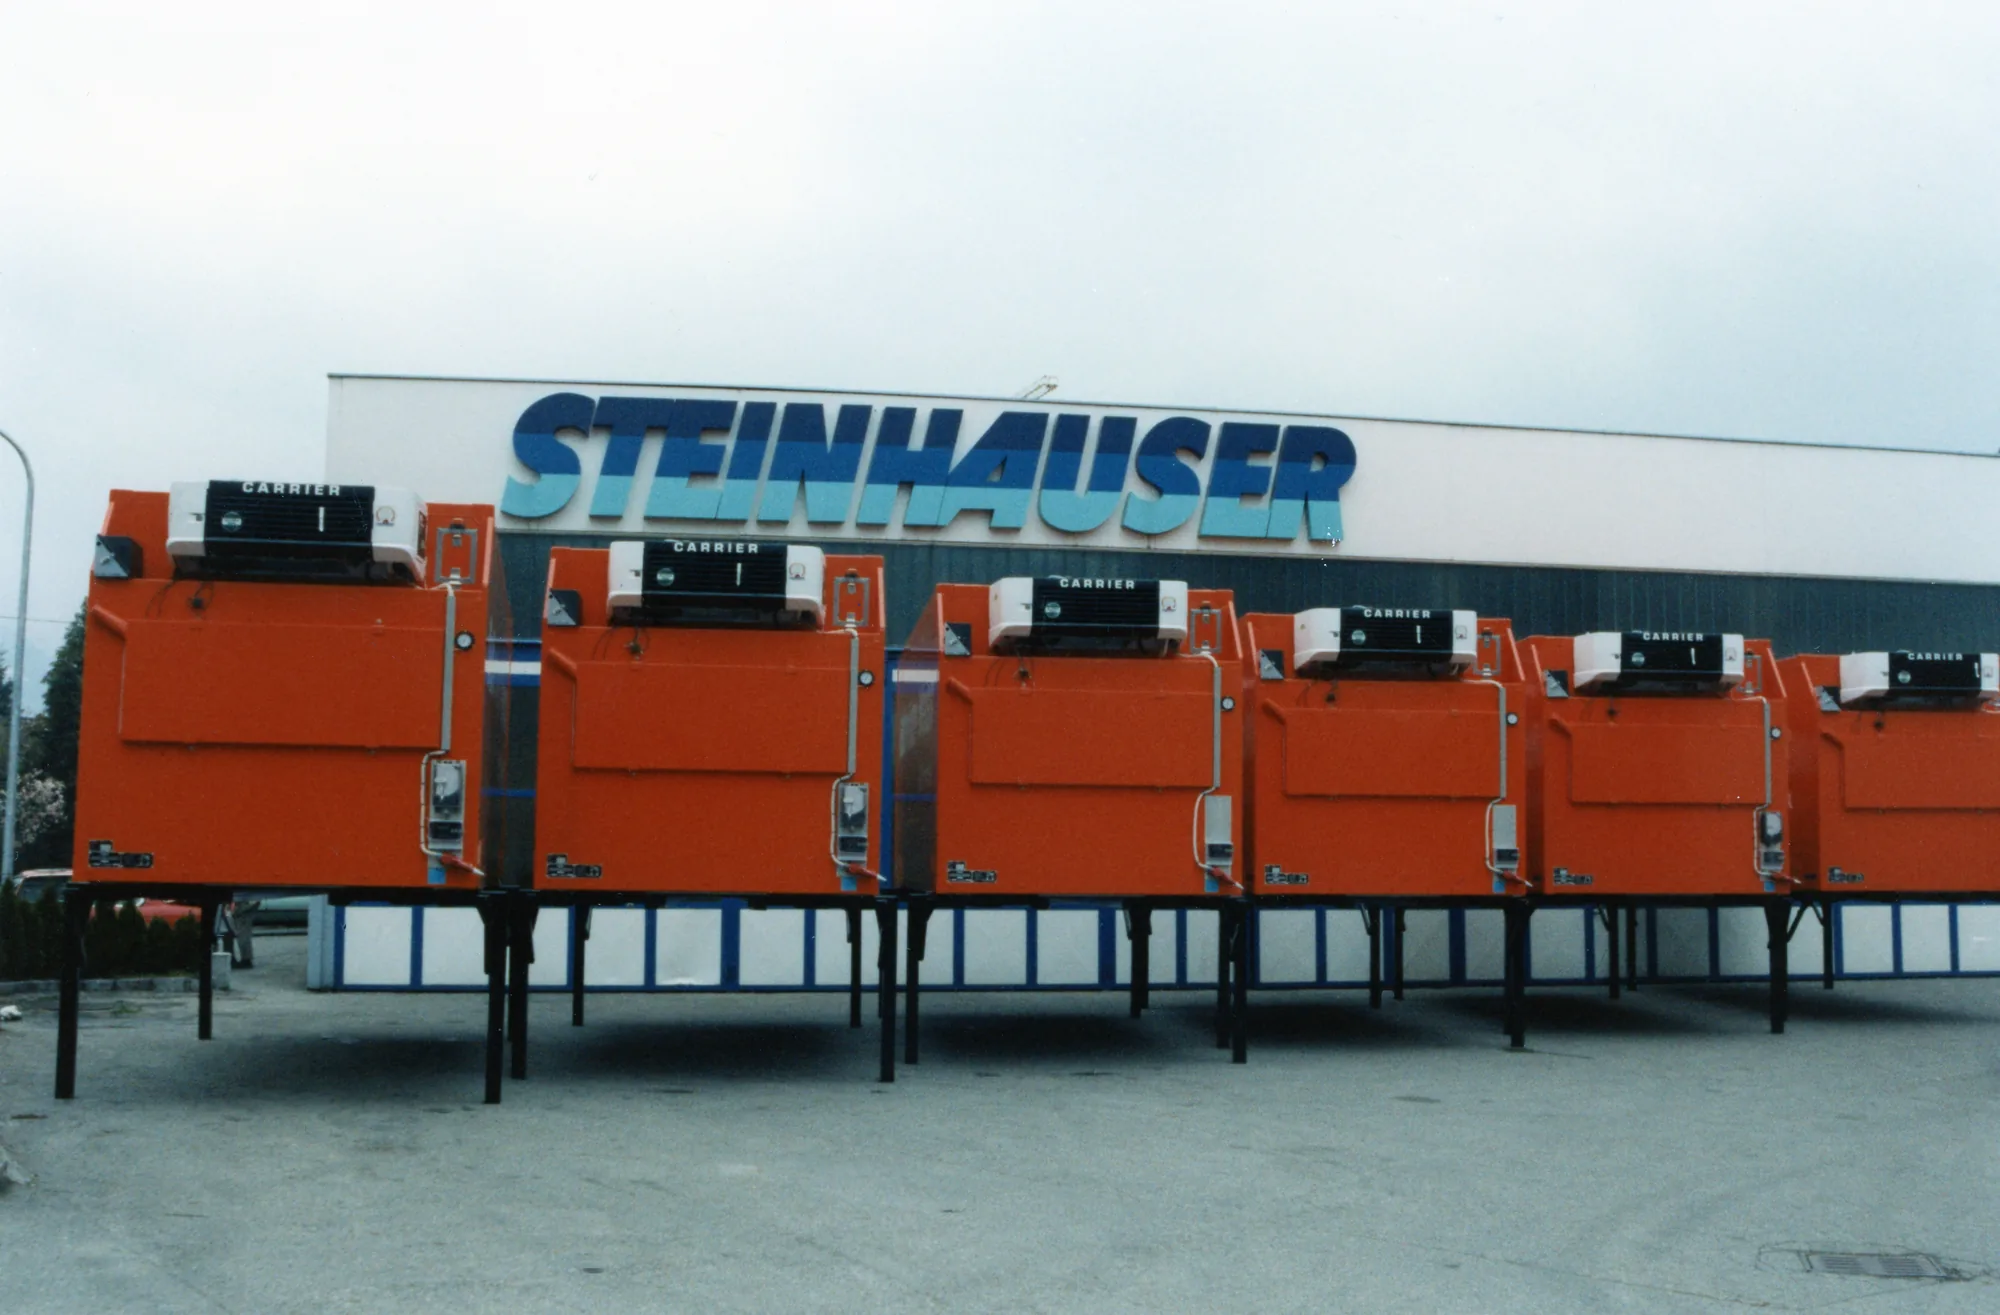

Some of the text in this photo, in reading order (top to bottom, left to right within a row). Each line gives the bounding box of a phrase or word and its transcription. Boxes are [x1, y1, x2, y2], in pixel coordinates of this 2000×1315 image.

[500, 392, 1357, 541] STEINHAUSER
[242, 481, 341, 496] CARRIER
[673, 541, 759, 553] CARRIER
[1059, 578, 1136, 589] CARRIER
[1363, 608, 1431, 619] CARRIER
[1642, 632, 1704, 641] CARRIER
[1907, 653, 1964, 661] CARRIER
